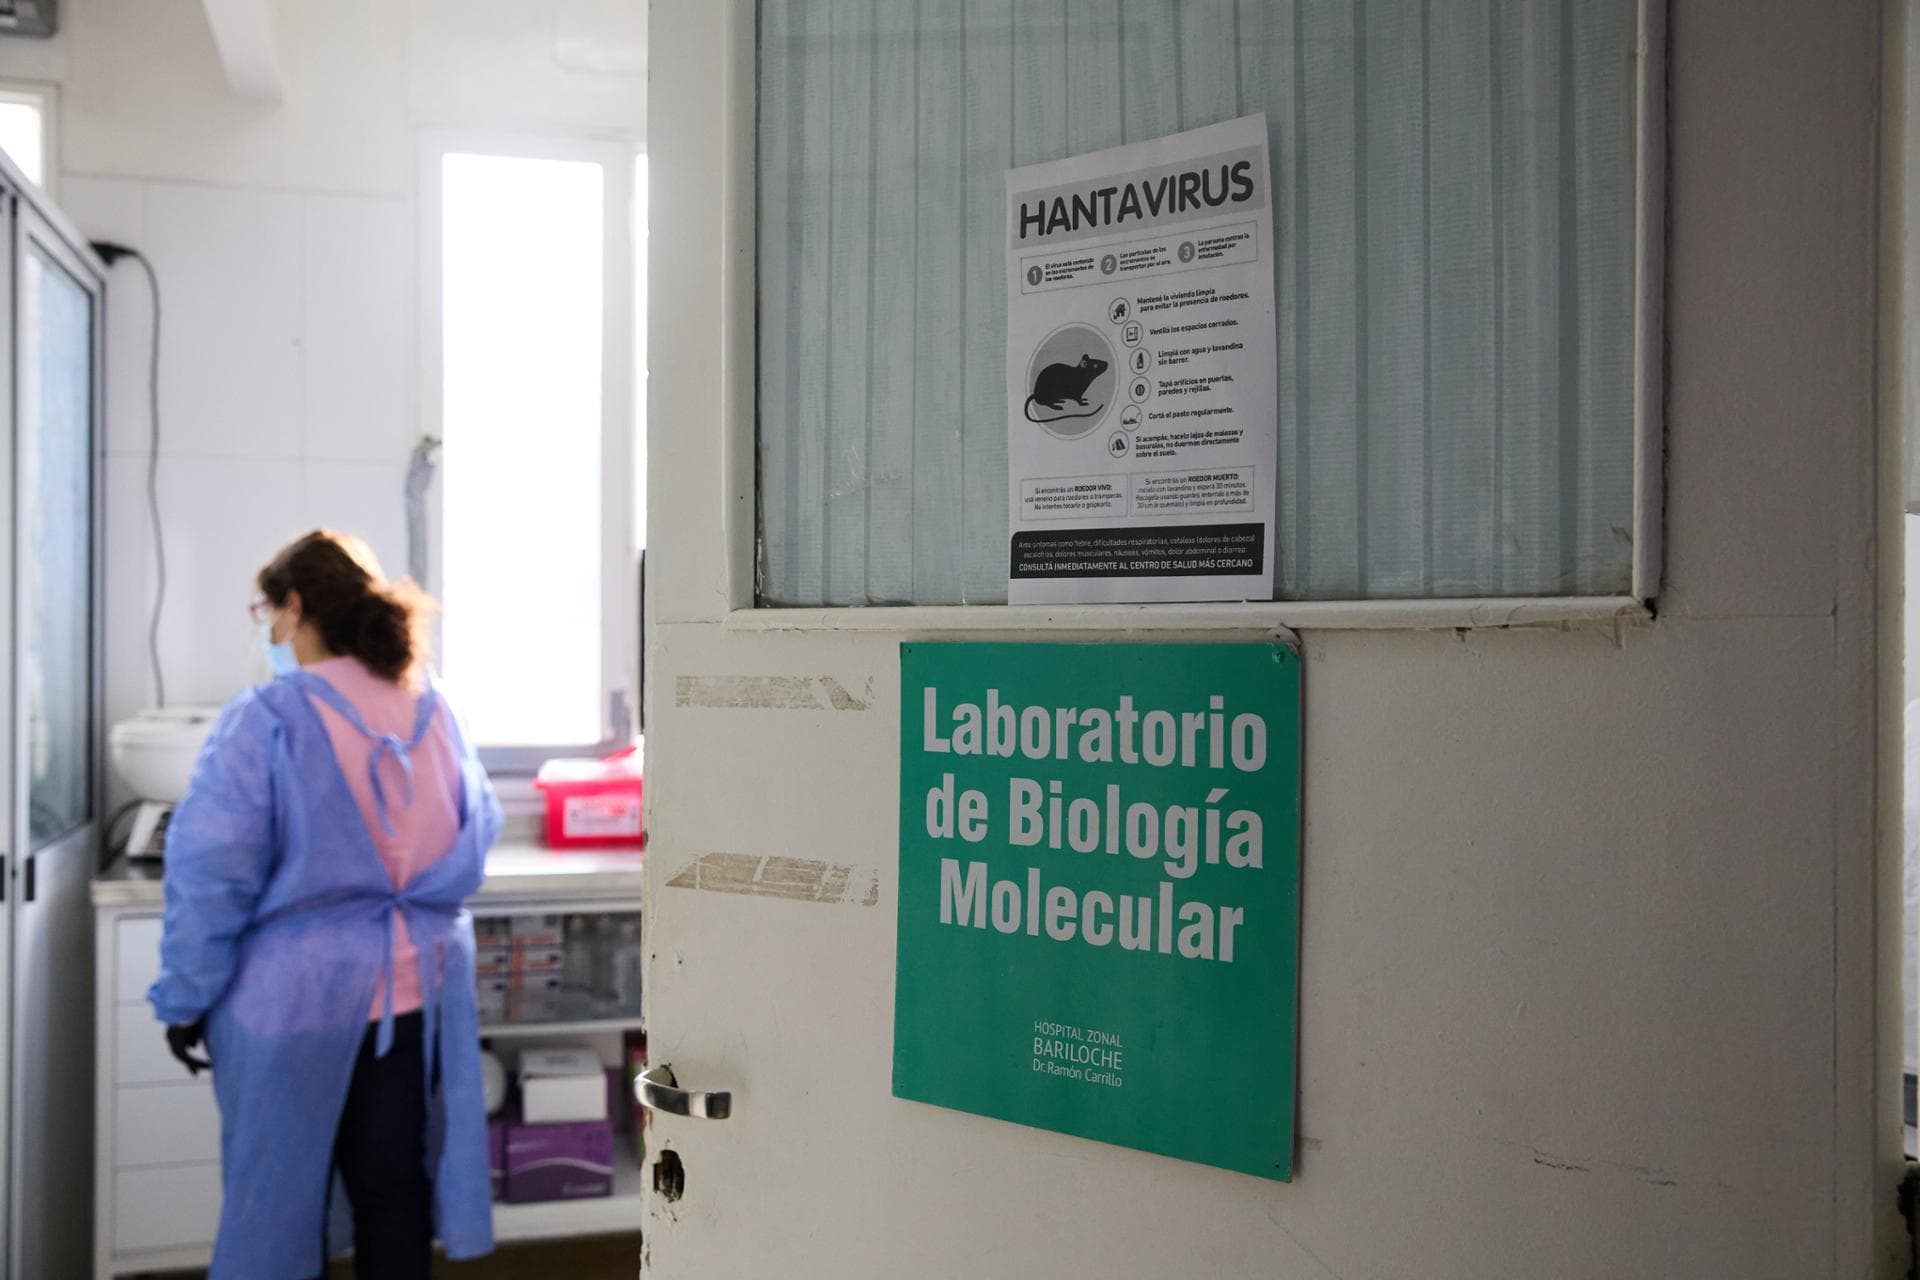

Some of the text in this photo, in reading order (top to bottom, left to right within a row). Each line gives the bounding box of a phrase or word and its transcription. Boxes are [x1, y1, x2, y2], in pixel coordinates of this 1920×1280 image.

[1020, 161, 1254, 239] HANTAVIRUS
[1137, 295, 1162, 304] Mantené
[1170, 290, 1195, 300] vivienda
[1196, 288, 1215, 297] limpia
[1140, 305, 1154, 313] para
[1155, 302, 1172, 310] evitar
[1179, 297, 1209, 309] presencia
[1219, 292, 1250, 302] roedores.
[1149, 326, 1169, 335] Ventilá
[1181, 322, 1207, 332] espacios
[1208, 319, 1239, 328] cerrados.
[1158, 349, 1179, 358] Limpiá
[1191, 347, 1206, 355] agua
[1212, 342, 1243, 352] lavandina
[1158, 357, 1189, 366] sin barrer.
[1158, 380, 1173, 388] Tapá
[1174, 377, 1198, 386] orificios
[1158, 387, 1183, 397] paredes
[1189, 386, 1212, 394] rejillas.
[1148, 412, 1165, 420] Cortá
[1172, 409, 1190, 419] pasto
[1191, 407, 1234, 417] regularmente.
[1136, 435, 1141, 443] Si
[1170, 432, 1190, 440] hacelo
[1190, 431, 1204, 439] lejos
[1214, 429, 1238, 437] malezas
[1174, 439, 1200, 448] duermas
[1201, 437, 1239, 446] directamente
[1136, 450, 1152, 458] sobre
[1213, 473, 1239, 481] MUERTO:
[1019, 561, 1053, 572] CONSULTÁ
[1054, 562, 1117, 571] INMEDIATAMENTE
[1130, 561, 1160, 569] CENTRO
[1161, 561, 1172, 569] DE
[1172, 560, 1197, 569] SALUD
[1199, 558, 1215, 568] MÁS
[1216, 558, 1253, 568] CERCANO
[924, 687, 1267, 772] Laboratorio
[926, 773, 1264, 879] de Biología
[939, 858, 1244, 963] Molecular
[1034, 1020, 1123, 1048] HOSPITAL ZONAL
[1034, 1037, 1123, 1070] BARILOCHE
[1033, 1059, 1122, 1087] Dr. Ramón Carrillo
